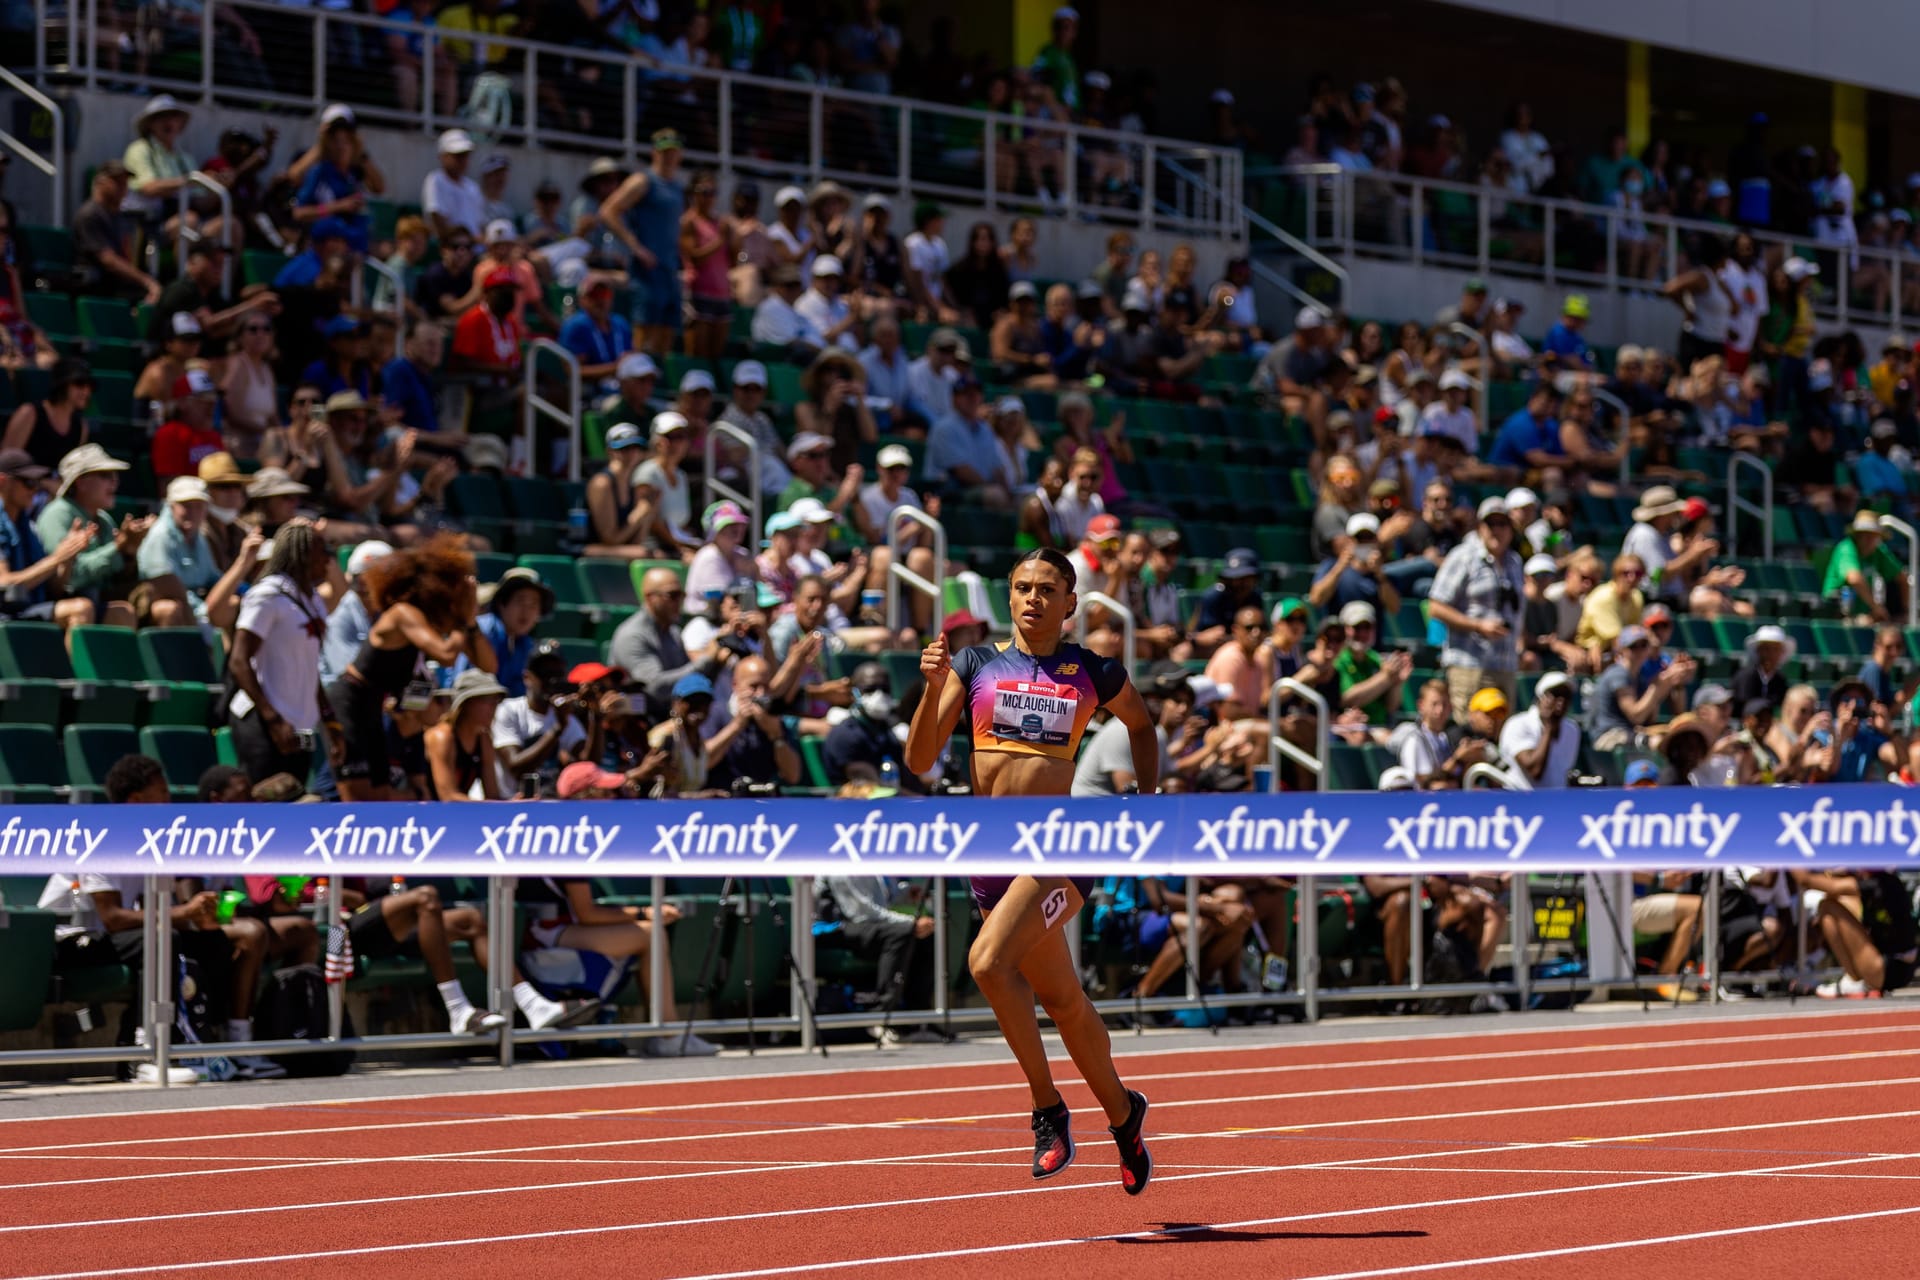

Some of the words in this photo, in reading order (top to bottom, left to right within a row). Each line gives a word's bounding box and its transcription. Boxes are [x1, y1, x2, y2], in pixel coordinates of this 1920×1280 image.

[1030, 685, 1056, 693] TOYOTA
[1002, 693, 1068, 715] MCLAUGHLIN
[0, 816, 109, 864] finity
[136, 815, 276, 864] xfinity
[304, 814, 447, 864] xfinity
[475, 812, 621, 863] xfinity
[649, 811, 798, 862] xfinity
[829, 809, 979, 862] xfinity
[1011, 807, 1164, 861] xfinity
[1193, 804, 1351, 861] xfinity
[1383, 802, 1544, 860] xfinity
[1577, 799, 1741, 859] xfinity
[1045, 891, 1064, 919] 5
